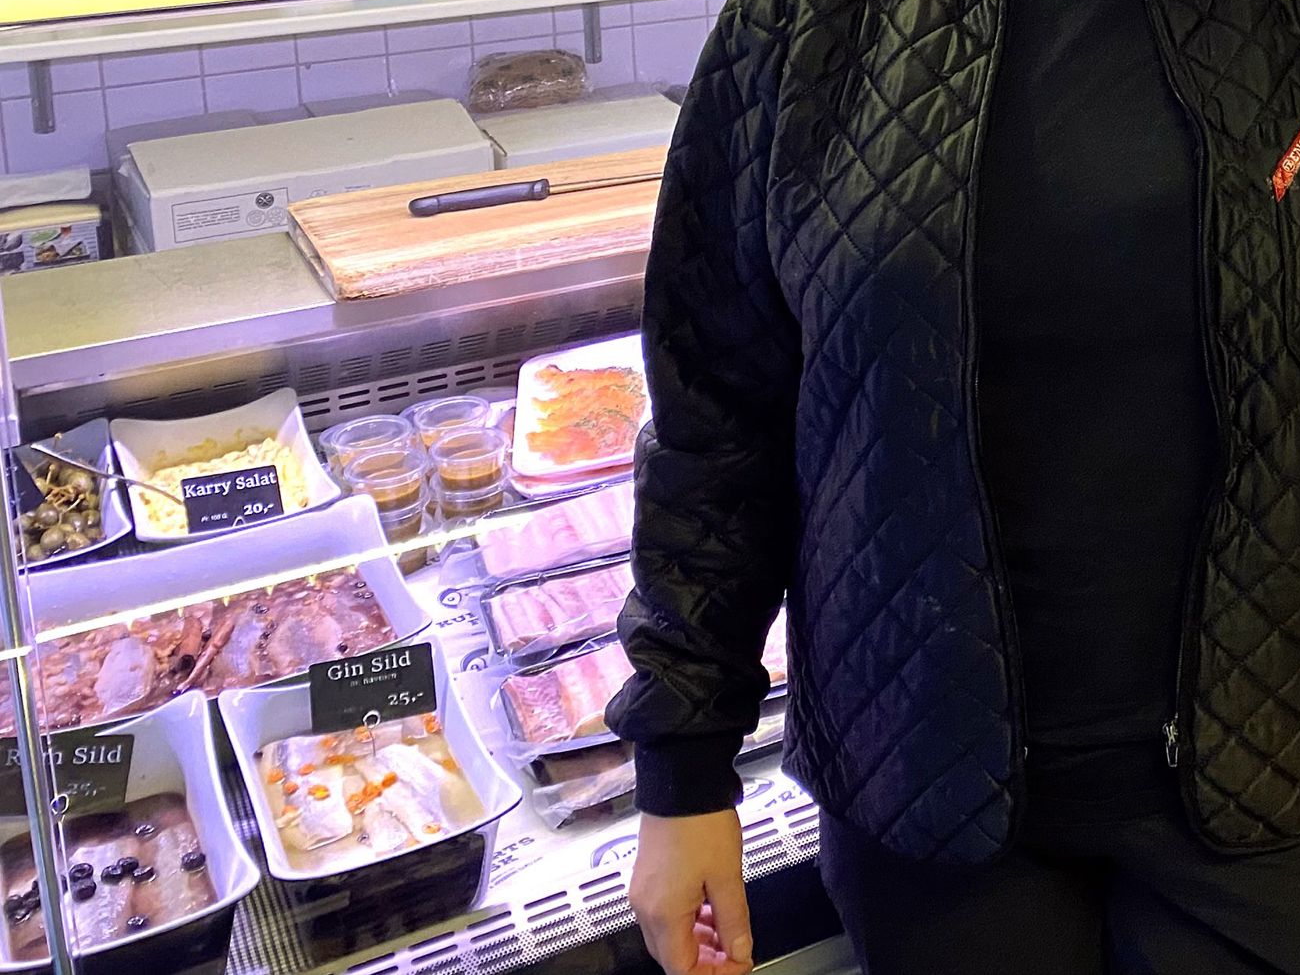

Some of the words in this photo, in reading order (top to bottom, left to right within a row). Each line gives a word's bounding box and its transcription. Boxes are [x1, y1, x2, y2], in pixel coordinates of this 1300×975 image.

[184, 481, 231, 498] Karry
[235, 472, 277, 490] Salat
[243, 503, 274, 515] 20,-
[327, 662, 364, 680] Gin
[371, 650, 411, 673] Sild
[72, 744, 122, 765] Sild
